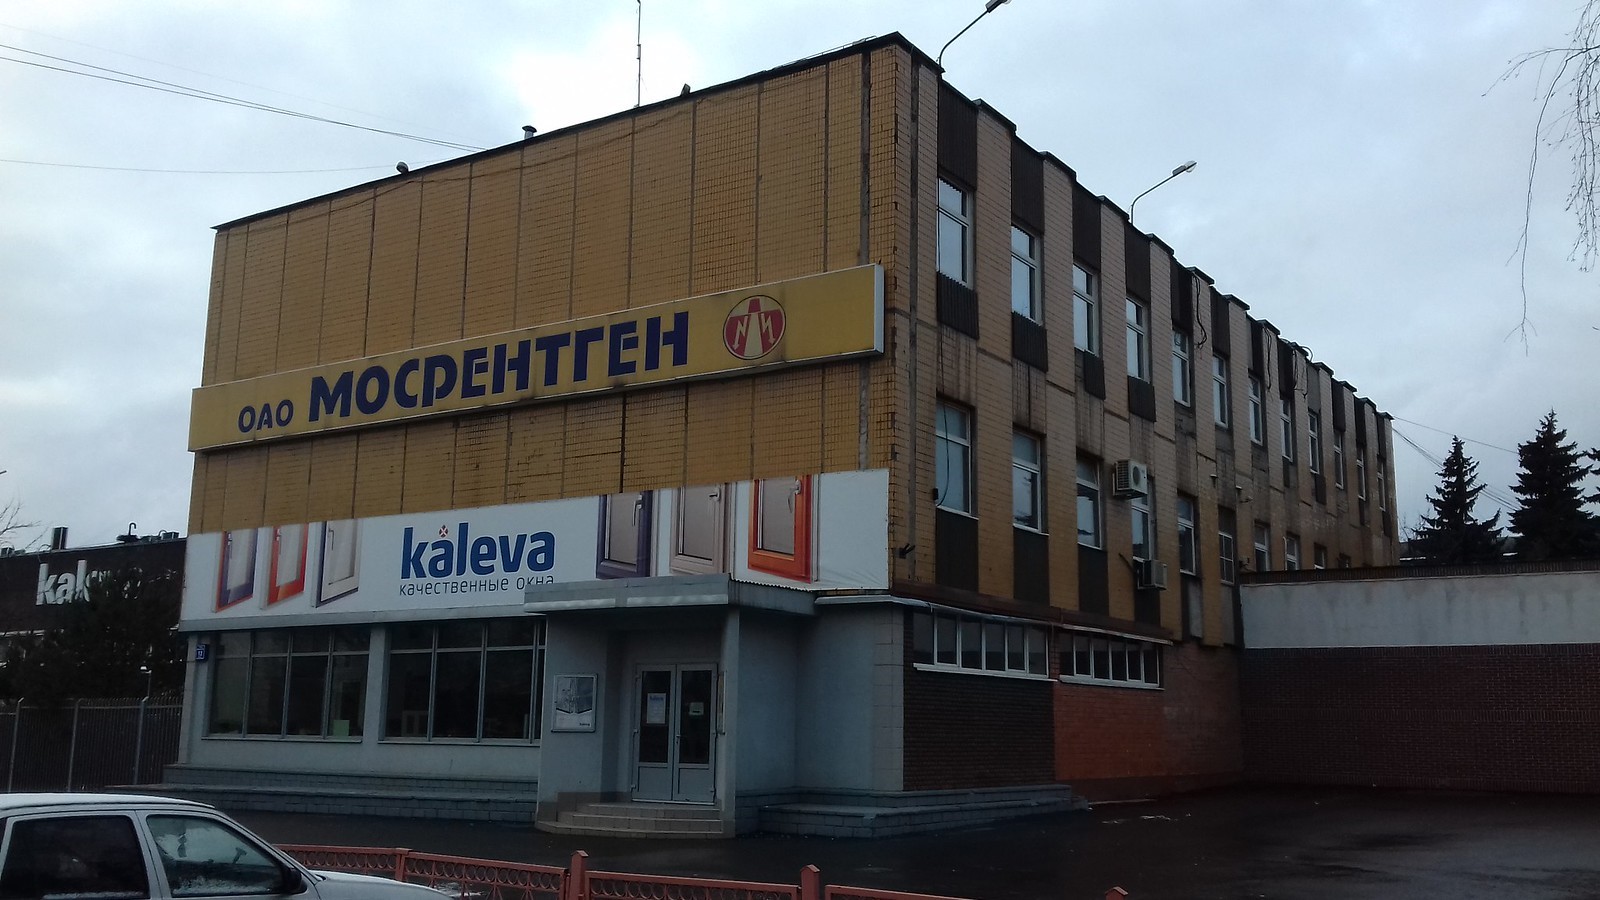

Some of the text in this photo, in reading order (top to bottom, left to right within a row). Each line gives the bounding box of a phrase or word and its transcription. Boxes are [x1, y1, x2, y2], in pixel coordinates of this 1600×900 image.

[238, 311, 689, 433] ОАО МОСРЕНТГЕН
[401, 522, 555, 580] kaleva
[400, 578, 508, 596] качественные
